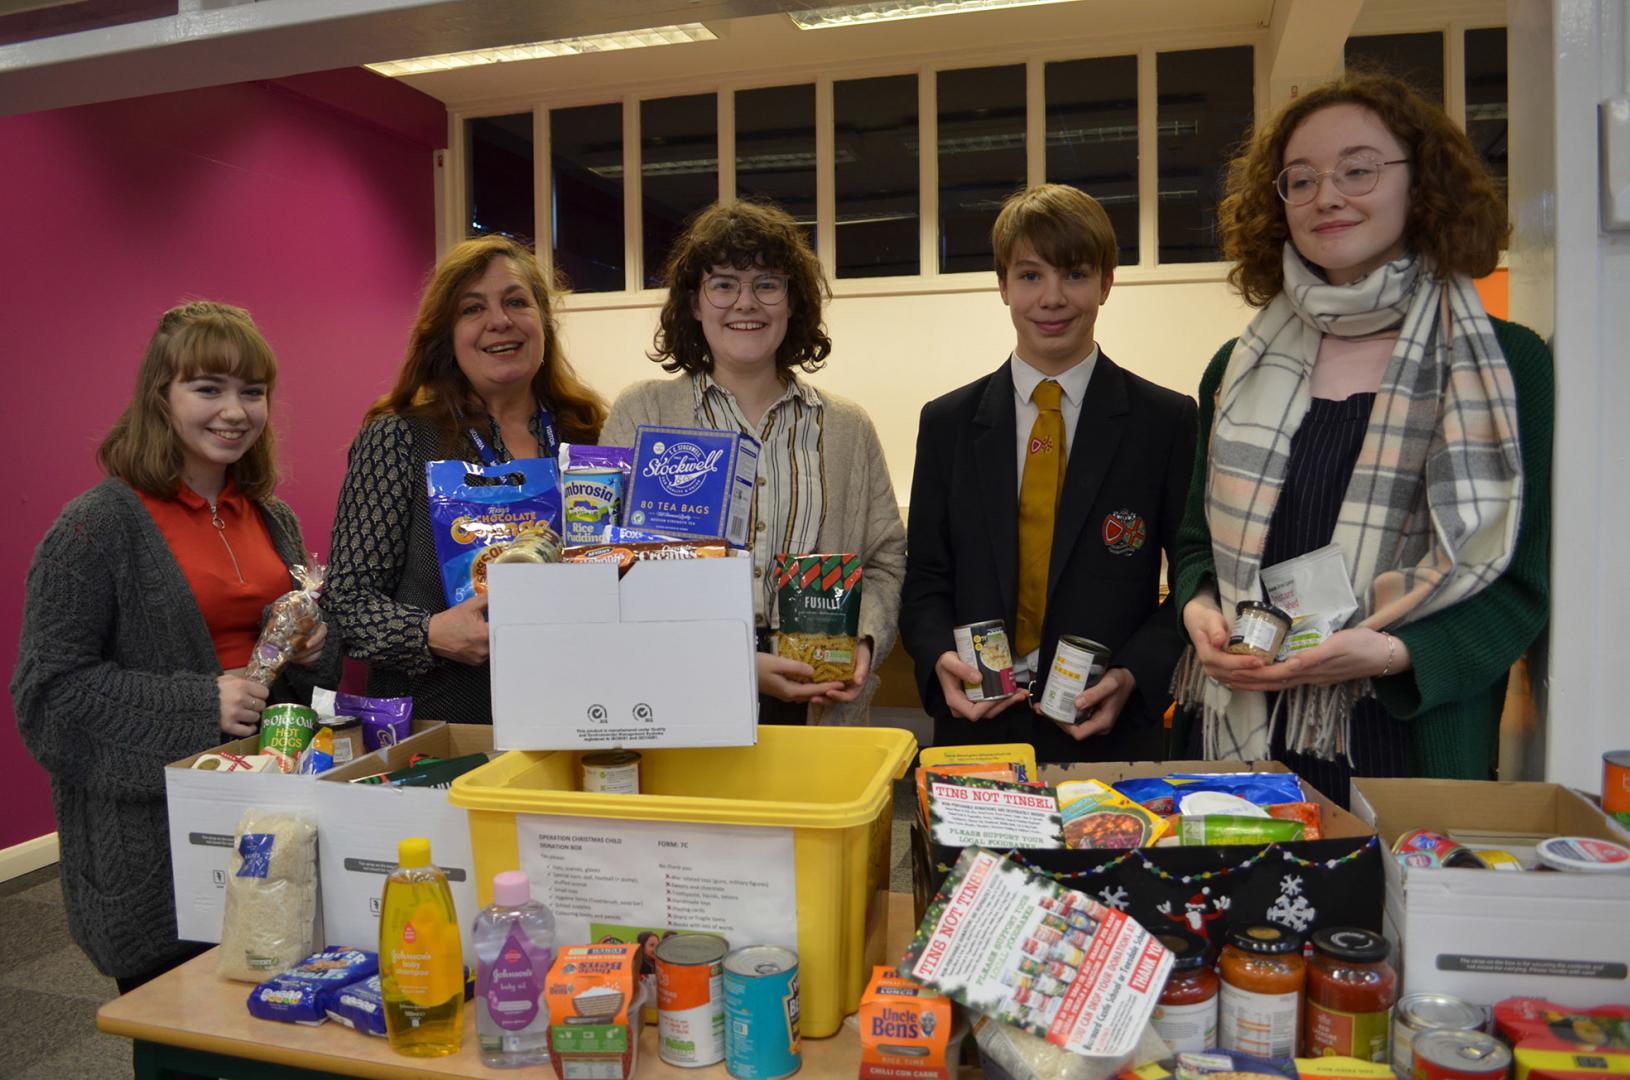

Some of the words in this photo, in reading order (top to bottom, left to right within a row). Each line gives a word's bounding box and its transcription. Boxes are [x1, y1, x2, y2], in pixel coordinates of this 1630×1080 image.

[643, 449, 723, 477] Stockwell
[565, 482, 612, 502] mbrosia
[641, 500, 653, 509] 80
[658, 502, 676, 511] TEA
[681, 504, 709, 514] BAGS
[476, 512, 536, 523] CHOCOLATE
[573, 522, 593, 532] Rice
[276, 728, 298, 737] HOT
[271, 737, 302, 748] DOGS
[936, 787, 968, 799] TINS
[973, 792, 1000, 802] NOT
[1003, 794, 1053, 809] TINSEL
[949, 828, 981, 837] PLEASE
[983, 830, 1020, 841] SUPPORT
[1023, 834, 1044, 843] YOUR
[959, 837, 986, 845] LOCAL
[918, 940, 946, 976] TINS
[940, 908, 964, 937] NOT
[957, 857, 993, 906] TINSEL
[976, 950, 998, 985] PLEASE
[995, 914, 1017, 949] SUPPORT
[1015, 894, 1029, 913] YOUR
[989, 950, 1008, 979] LOCAL
[1006, 904, 1034, 949] FOODBANKS
[1134, 956, 1157, 989] THANK
[1147, 940, 1163, 957] YO
[493, 967, 532, 983] Johnson's
[500, 983, 516, 992] baby
[1072, 1027, 1086, 1044] YOU
[1081, 1011, 1094, 1027] CAN
[1089, 992, 1102, 1010] DROP
[1098, 972, 1113, 992] YOUR
[1107, 934, 1132, 971] DONATIONS
[1096, 1003, 1112, 1022] Castle
[1106, 982, 1122, 1002] School
[1120, 945, 1139, 972] Teesdale
[883, 1008, 917, 1022] Uncle
[872, 1016, 918, 1038] Bens
[870, 1067, 894, 1075] CHILLI
[895, 1068, 912, 1076] CON
[913, 1069, 938, 1078] CARNE
